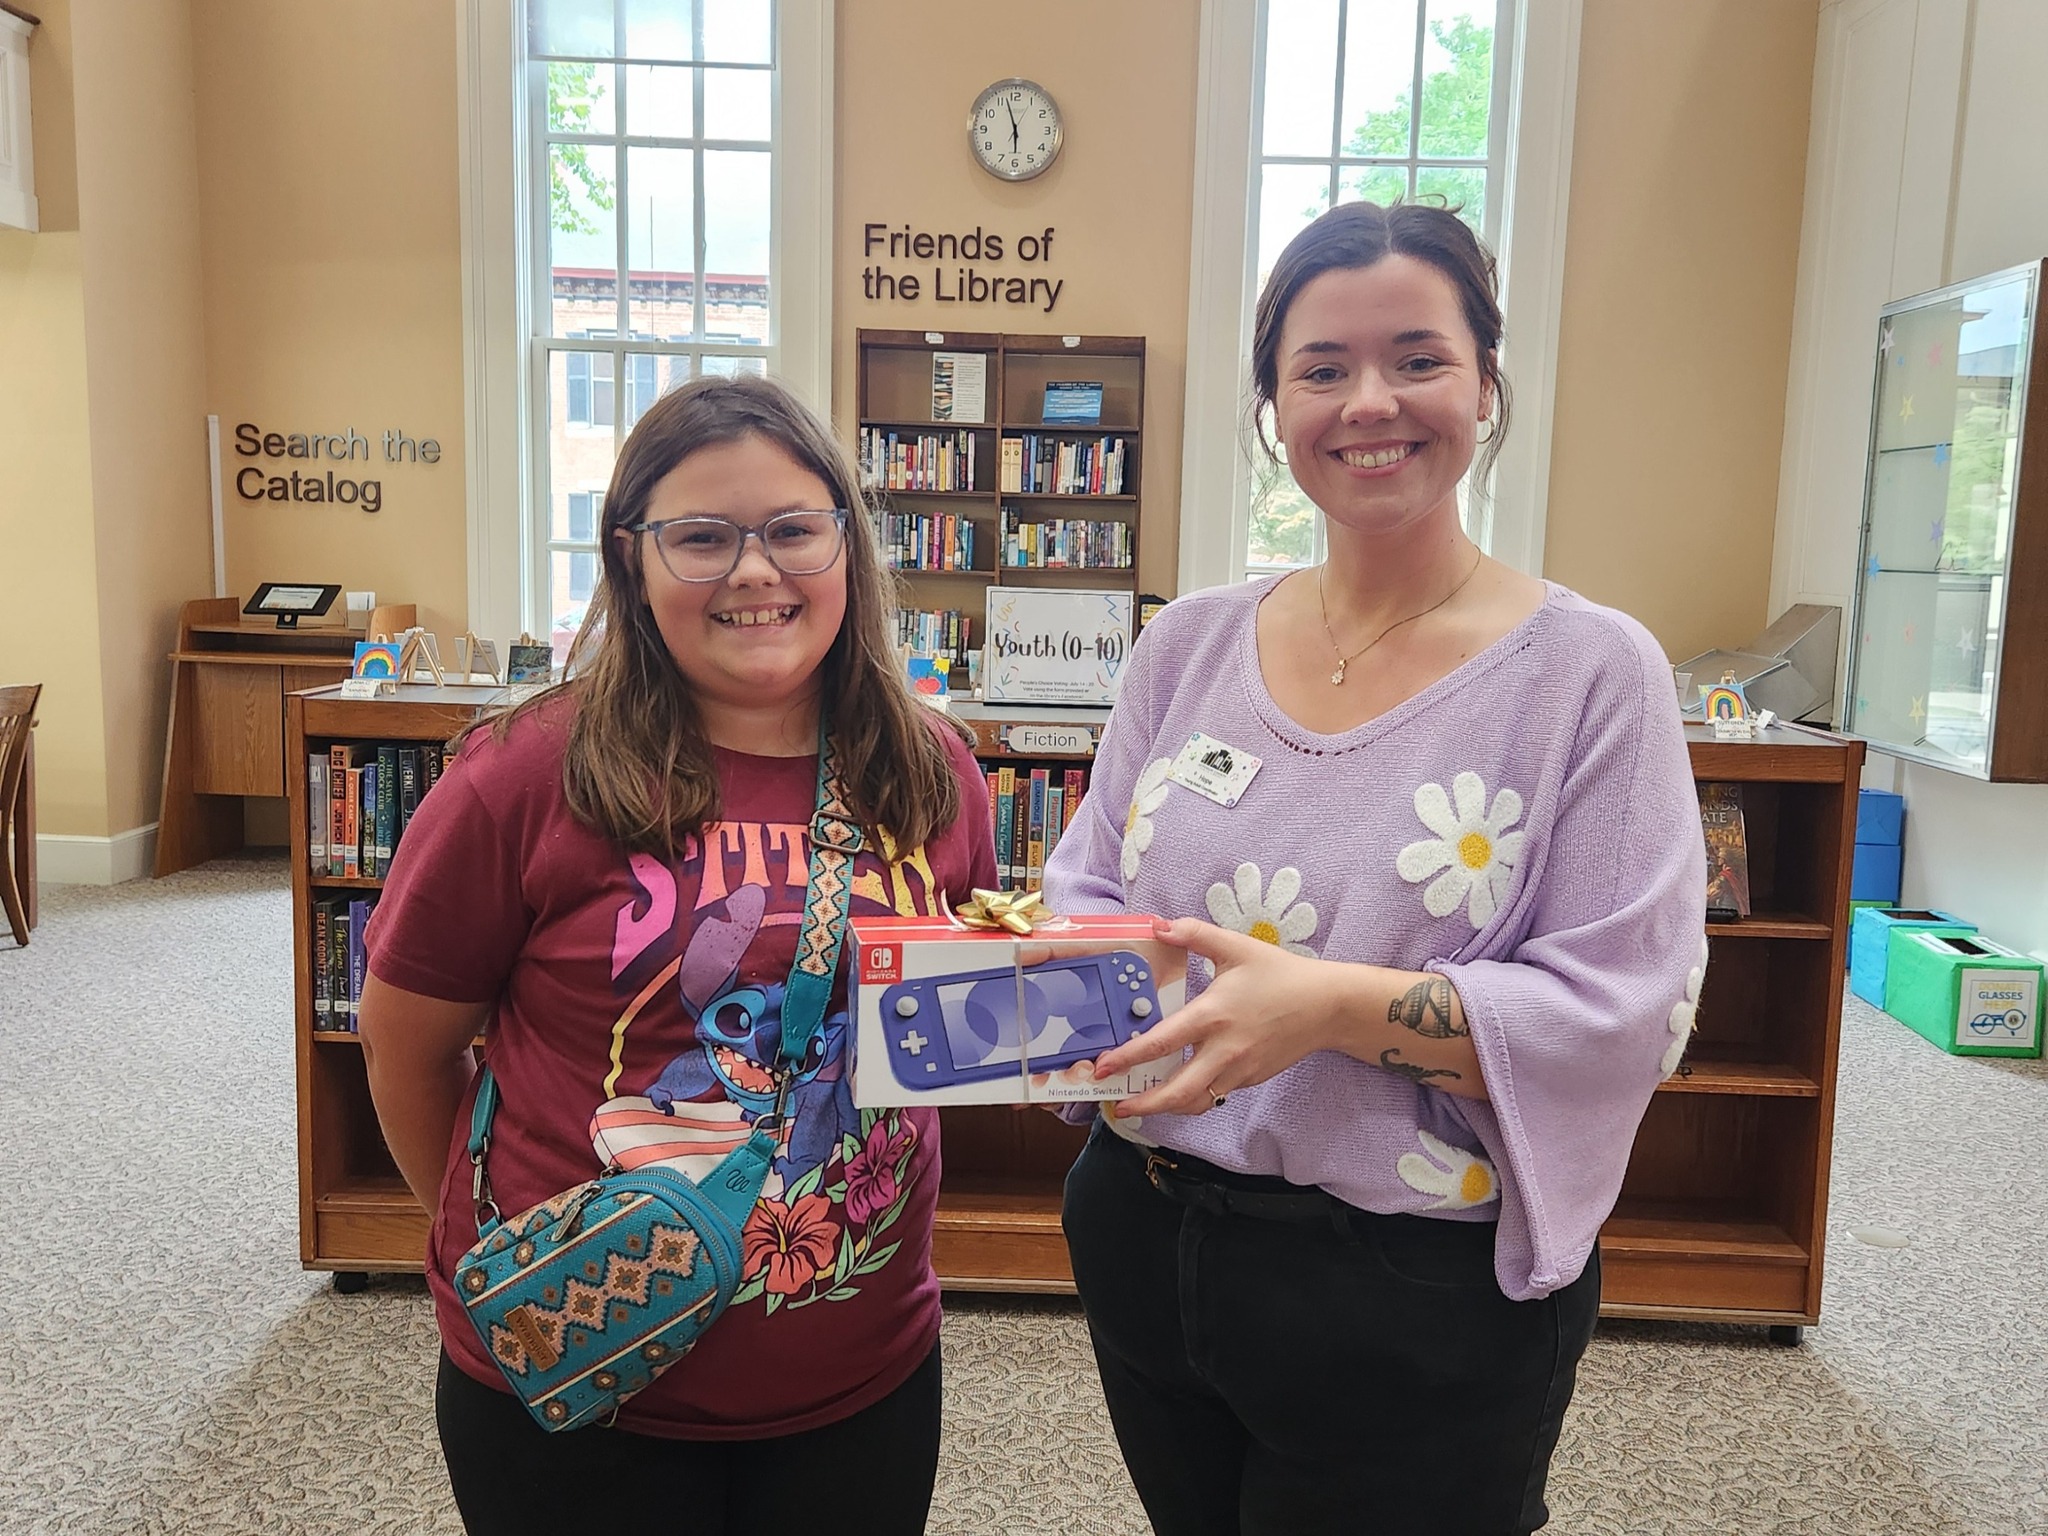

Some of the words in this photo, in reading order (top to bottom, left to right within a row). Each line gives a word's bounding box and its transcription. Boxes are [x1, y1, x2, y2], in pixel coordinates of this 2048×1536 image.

[997, 97, 1004, 106] 11
[1010, 92, 1022, 102] 12
[985, 108, 996, 119] 10
[1038, 109, 1047, 119] 2
[979, 125, 988, 134] 9
[1043, 126, 1051, 136] 3
[984, 141, 993, 151] 8
[1037, 142, 1046, 152] 4
[997, 153, 1006, 163] 7
[1011, 158, 1019, 168] 6
[1026, 154, 1035, 164] 5
[864, 223, 1003, 261] Friends
[1017, 227, 1055, 262] of
[862, 265, 920, 300] the
[935, 267, 1064, 313] Library
[234, 423, 369, 461] Search
[382, 428, 441, 464] the
[236, 466, 382, 514] Catalog
[994, 632, 1056, 659] Youth
[1062, 630, 1125, 662] (0-10)
[1023, 732, 1077, 748] Fiction
[378, 755, 386, 789] O'CLOCK
[403, 760, 413, 798] OVERKILL
[332, 771, 345, 798] CHIEF
[1068, 784, 1077, 796] THE
[378, 790, 386, 810] CLUB
[1050, 796, 1059, 829] Playing
[317, 912, 326, 938] DEAN
[336, 927, 348, 942] The
[317, 939, 327, 976] KOONTZ
[336, 943, 348, 970] Thorns
[353, 954, 361, 969] THE
[353, 969, 361, 994] DREAM
[866, 973, 897, 981] SWITCH
[1978, 991, 2023, 1001] GLASSES
[1048, 1087, 1090, 1097] Nintendo
[1092, 1086, 1124, 1096] Switch
[1127, 1073, 1162, 1095] Lit
[515, 1314, 548, 1363] Wrangler
